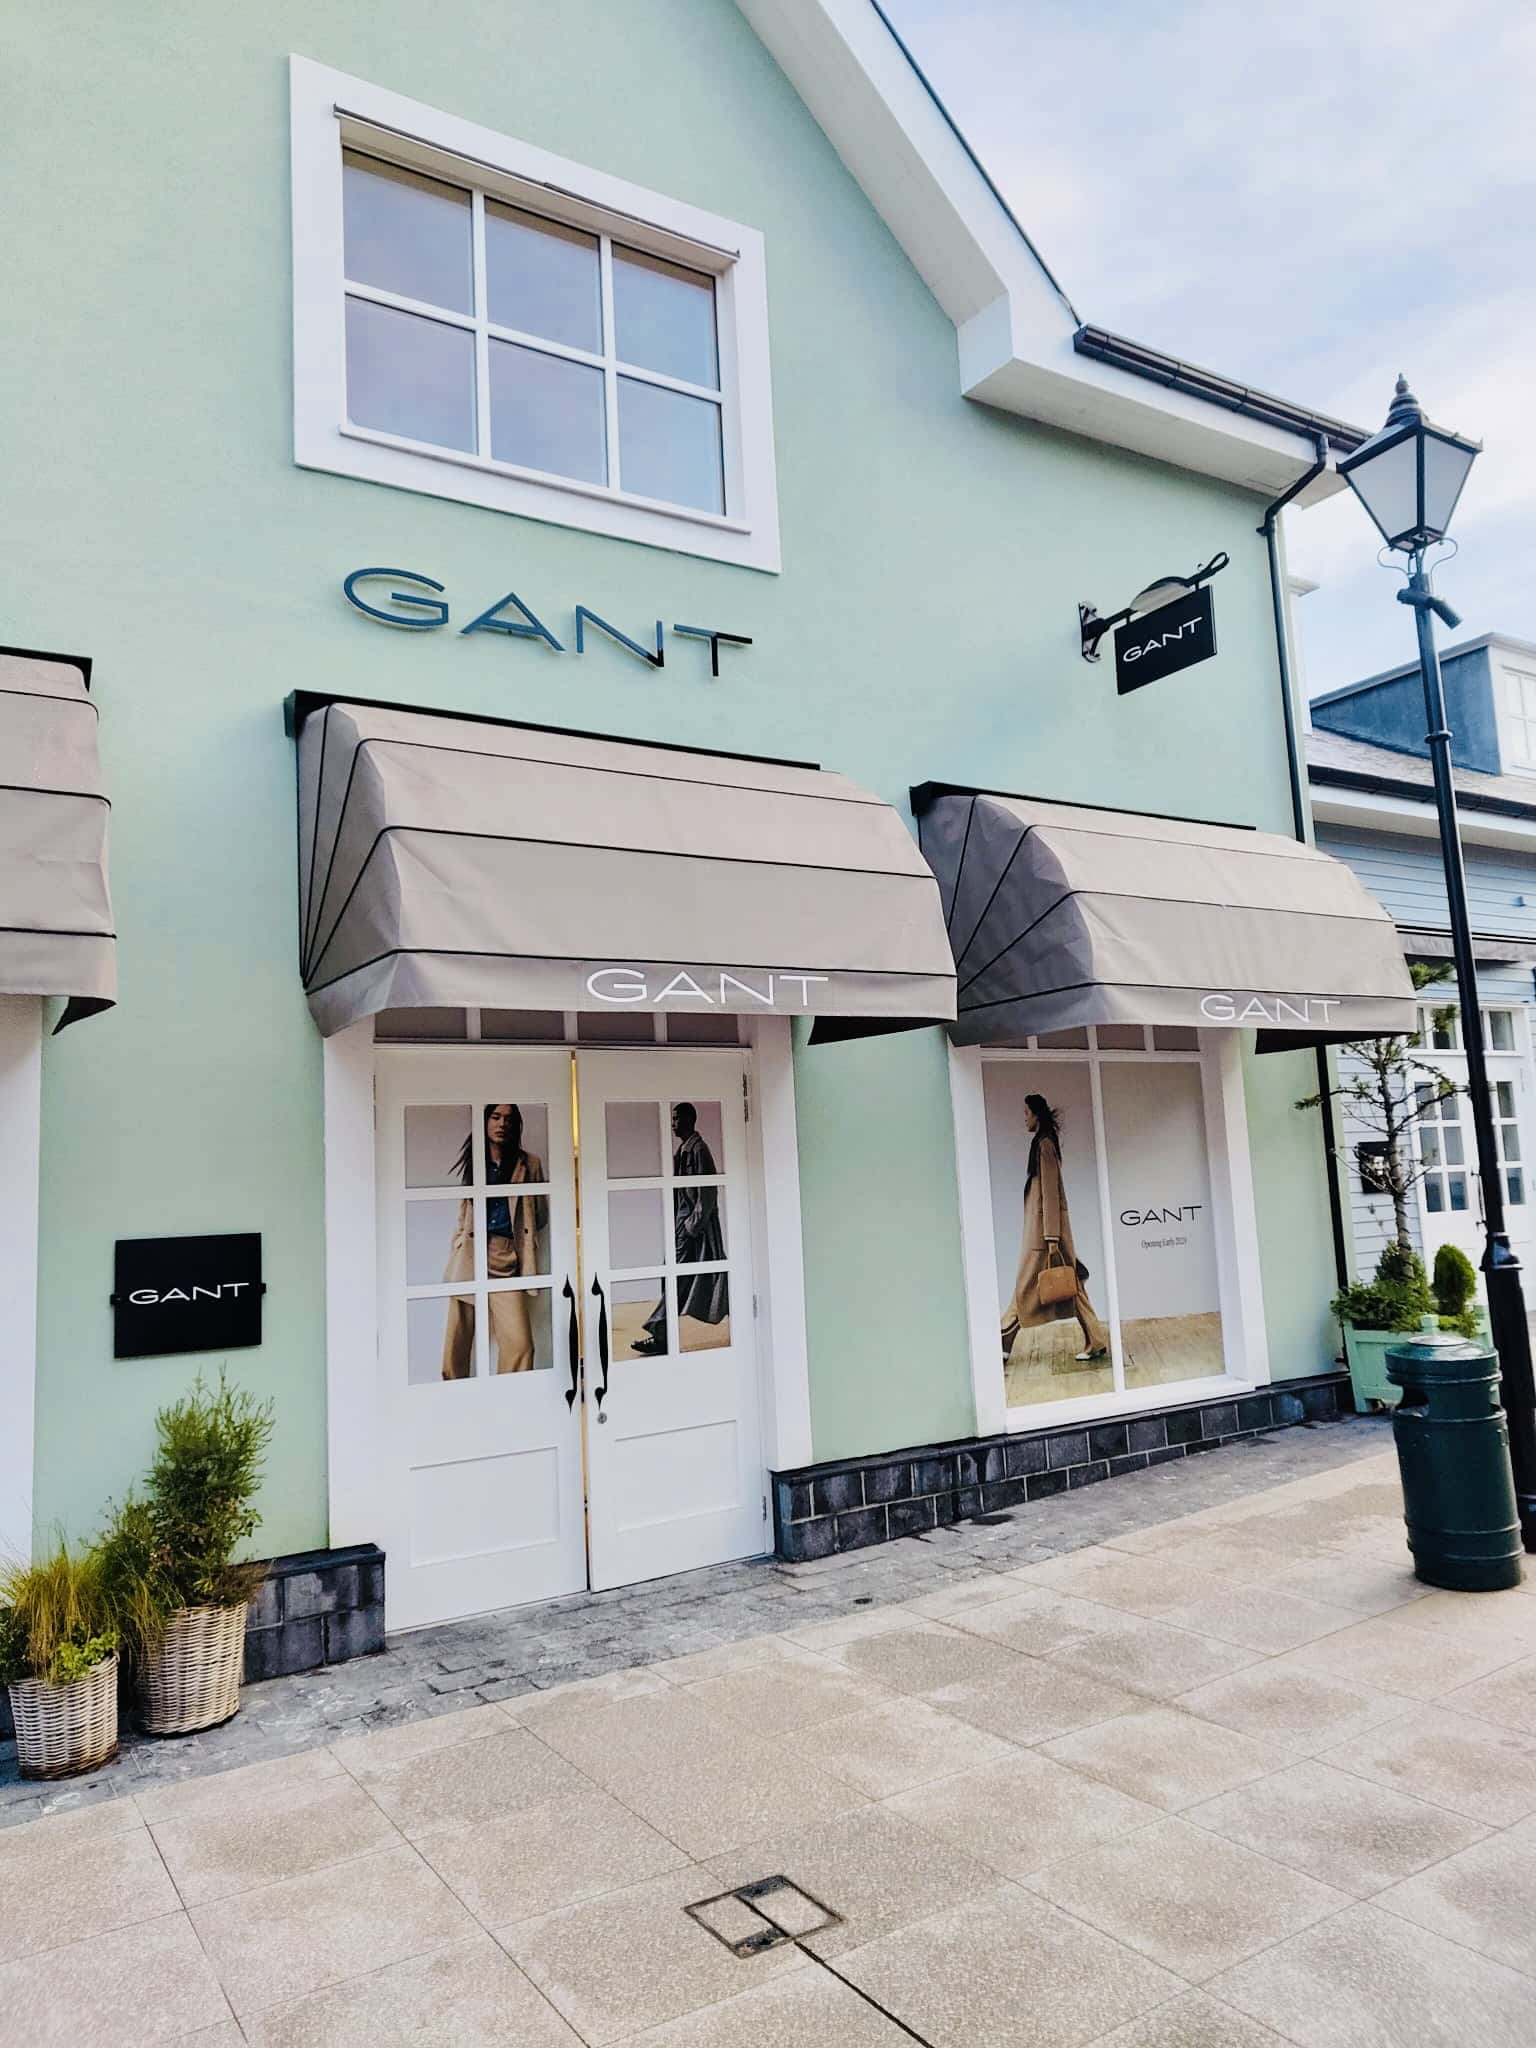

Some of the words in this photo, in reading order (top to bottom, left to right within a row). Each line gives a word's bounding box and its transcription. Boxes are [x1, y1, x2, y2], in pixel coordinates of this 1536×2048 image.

[343, 567, 753, 677] GANT
[1122, 616, 1203, 662] GANT
[586, 968, 829, 1006] GANT
[1200, 994, 1341, 1024] GANT
[1120, 1206, 1202, 1226] GANT
[129, 1282, 249, 1305] GANT
